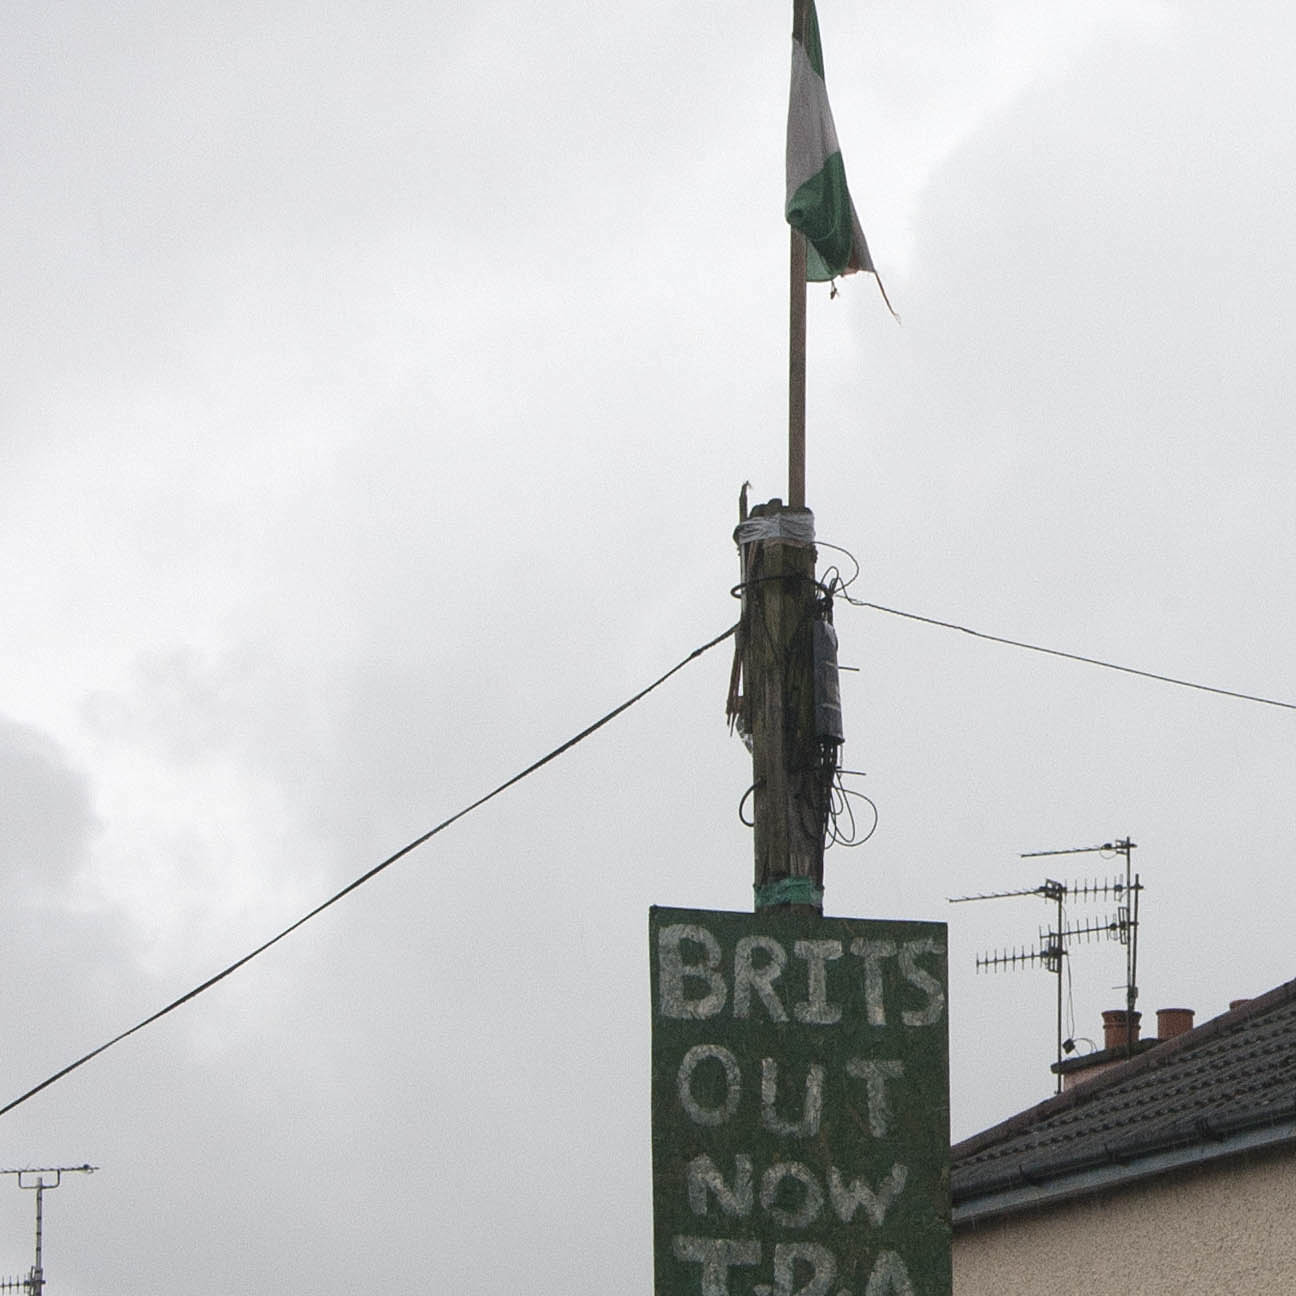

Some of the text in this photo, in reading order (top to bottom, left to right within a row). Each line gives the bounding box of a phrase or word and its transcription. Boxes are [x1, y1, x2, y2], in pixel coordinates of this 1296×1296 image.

[658, 924, 946, 1026] BRITS
[678, 1044, 904, 1138] OUT
[688, 1153, 908, 1228] NOW
